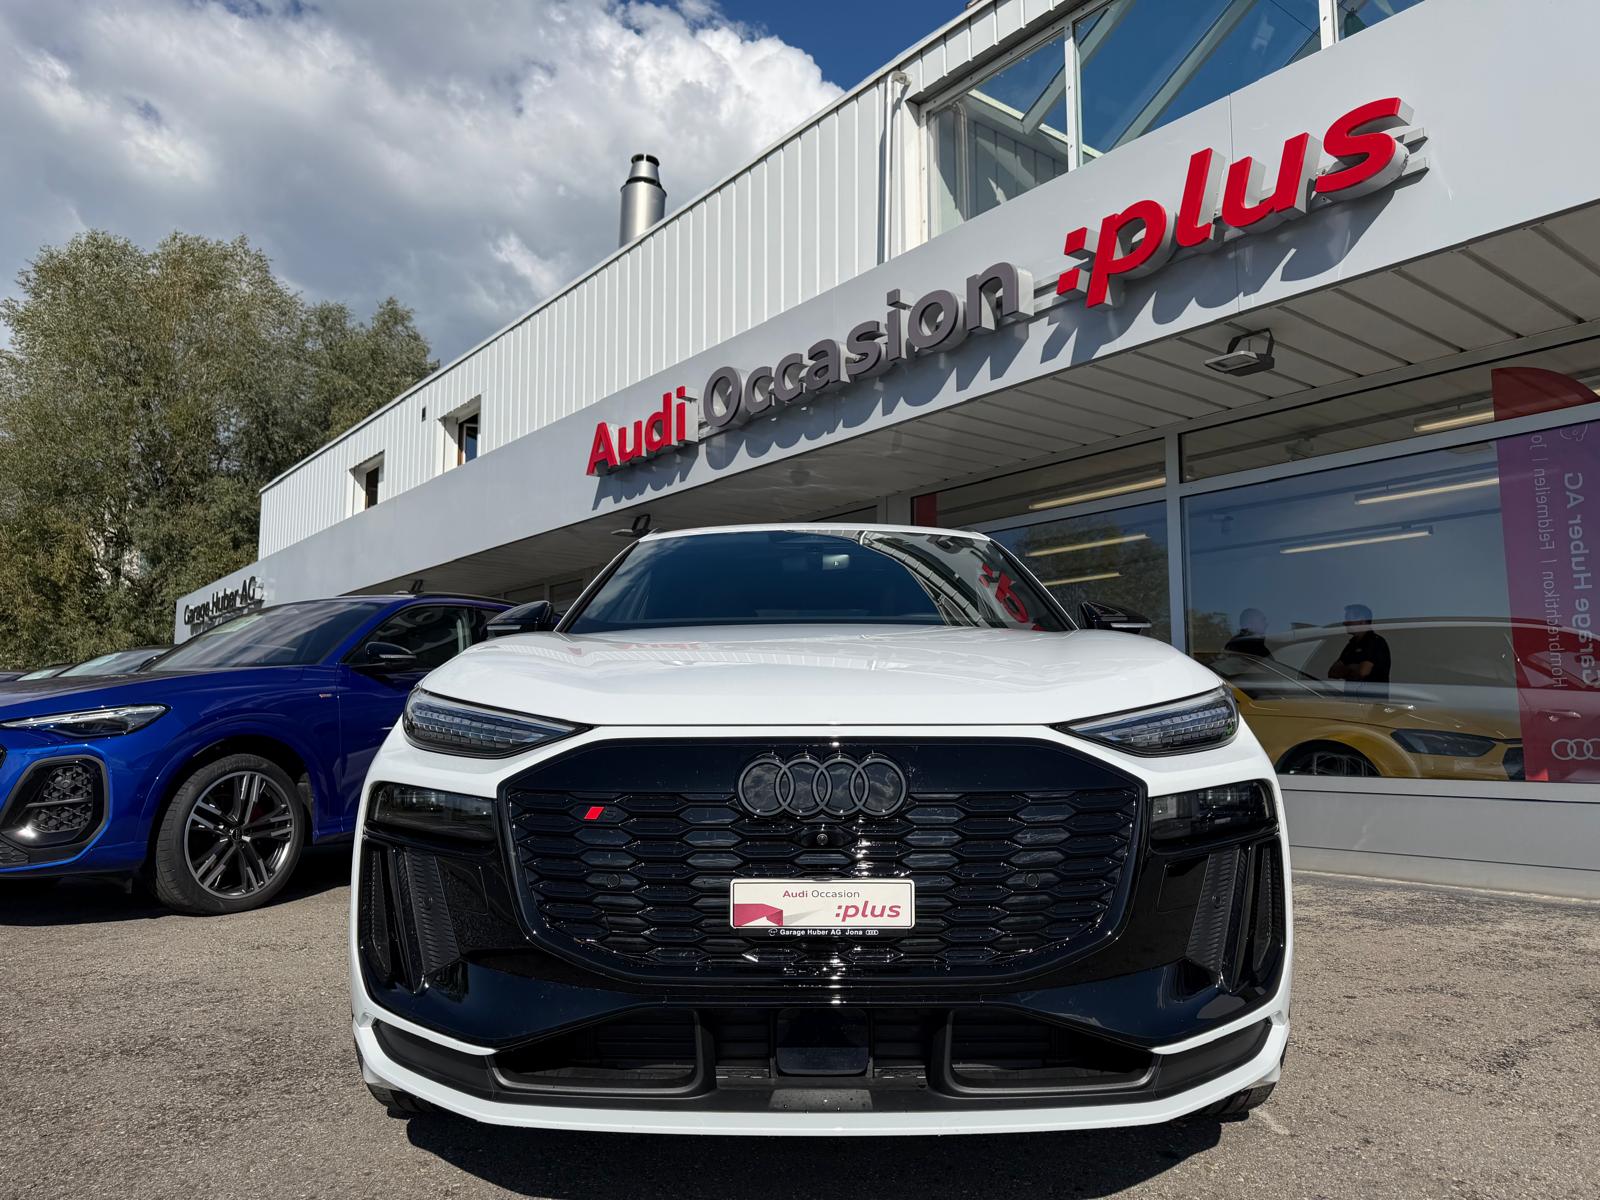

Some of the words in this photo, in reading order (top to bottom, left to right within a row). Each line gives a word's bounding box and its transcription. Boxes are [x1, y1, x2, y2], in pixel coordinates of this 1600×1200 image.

[585, 385, 688, 476] Audi
[703, 262, 1022, 428] Occasion
[1056, 97, 1402, 308] :plus
[184, 601, 210, 625] Garage
[212, 588, 240, 614] Huber
[240, 575, 257, 605] AG
[782, 889, 808, 898] Audi
[811, 889, 860, 898] Occasion
[835, 900, 902, 922] :plus
